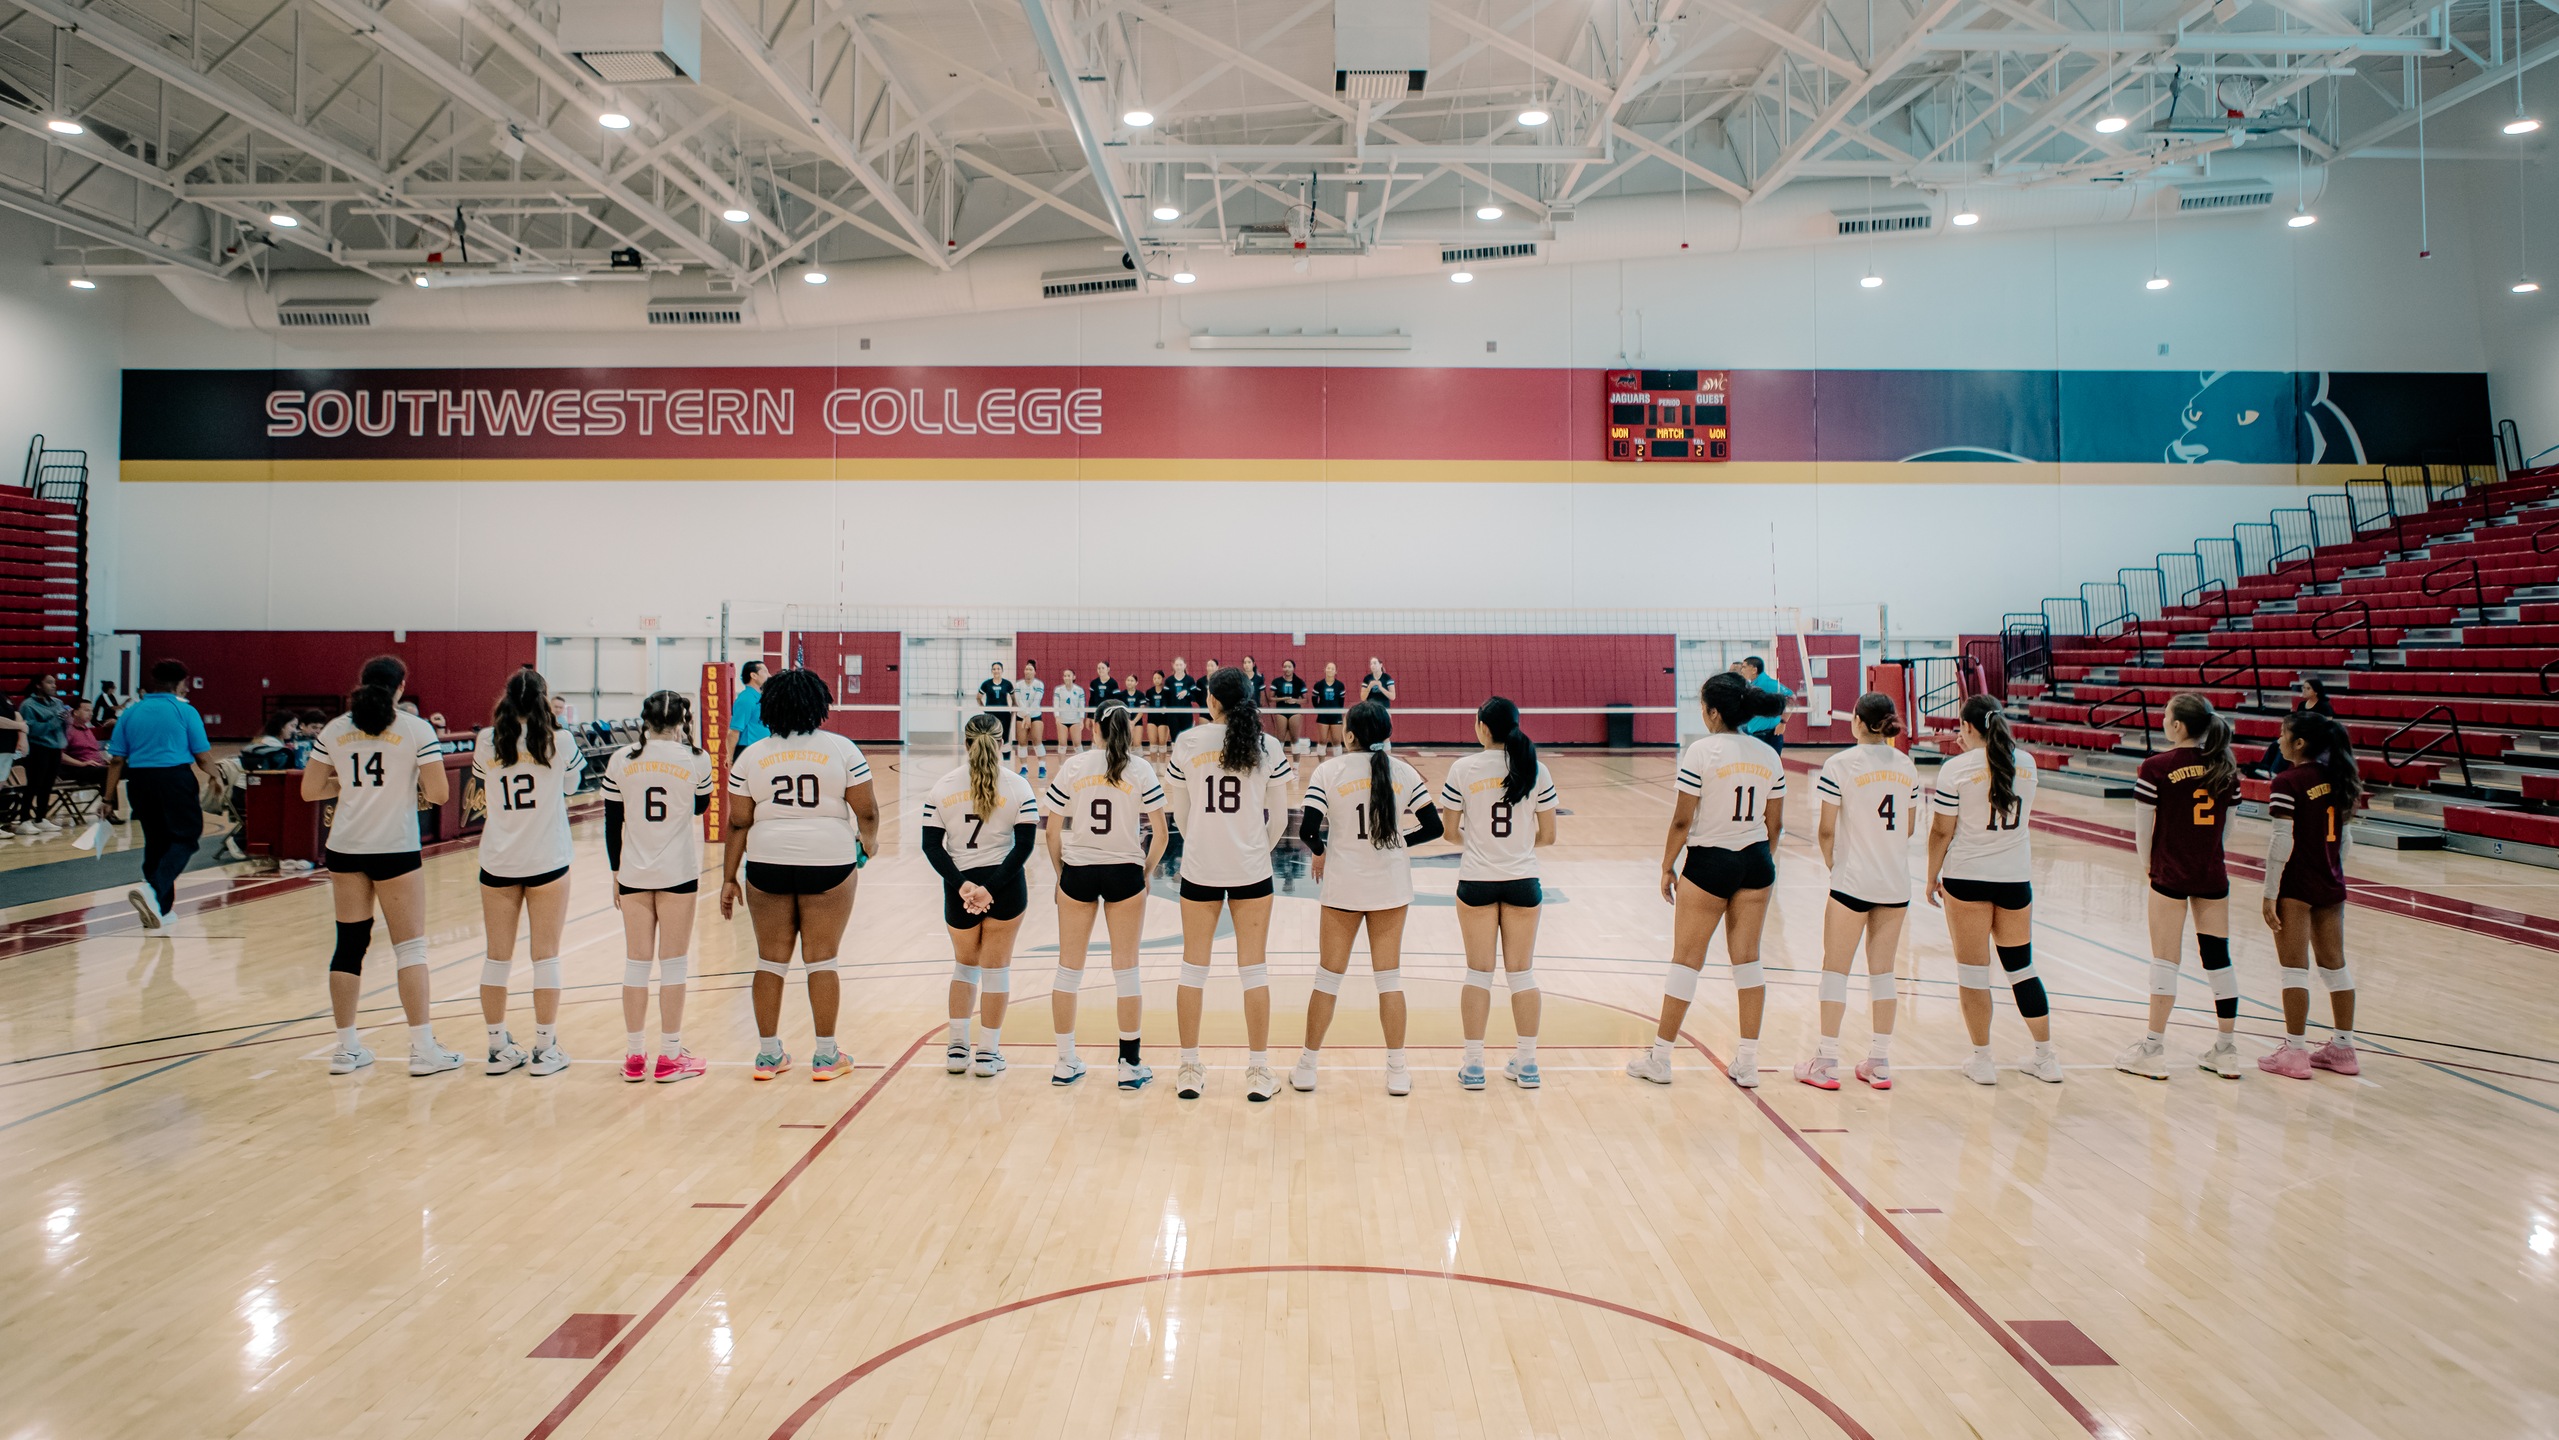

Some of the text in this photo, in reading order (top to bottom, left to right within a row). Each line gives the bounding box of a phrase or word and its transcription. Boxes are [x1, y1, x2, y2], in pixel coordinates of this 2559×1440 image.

[265, 387, 1102, 438] SOUTHWESTERN COLLEGE
[1610, 393, 1651, 404] JAGUARS
[1657, 398, 1681, 407] PERIOD
[1696, 393, 1725, 405] GUEST
[1611, 427, 1629, 439] WON
[1656, 427, 1685, 439] MATCH
[1709, 428, 1726, 439] WON
[1025, 692, 1031, 700] 7
[1066, 697, 1071, 705] 4
[351, 752, 385, 787] 14
[623, 760, 691, 781] SOUTHWESTERN
[706, 666, 721, 840] SOUTHWESTERN
[758, 750, 829, 769] SOUTHWESTERN
[1715, 762, 1773, 780] SOUTHWESTERN
[1854, 769, 1913, 787] SOUTHWESTERN
[500, 774, 536, 810] 12
[645, 786, 667, 822] 6
[771, 773, 820, 808] 20
[1205, 775, 1241, 813] 18
[1732, 786, 1755, 821] 11
[2193, 788, 2215, 825] 2
[1090, 798, 1112, 835] 9
[1491, 802, 1512, 838] 8
[1877, 794, 1896, 831] 4
[2326, 806, 2336, 842] 1
[965, 813, 985, 849] 7
